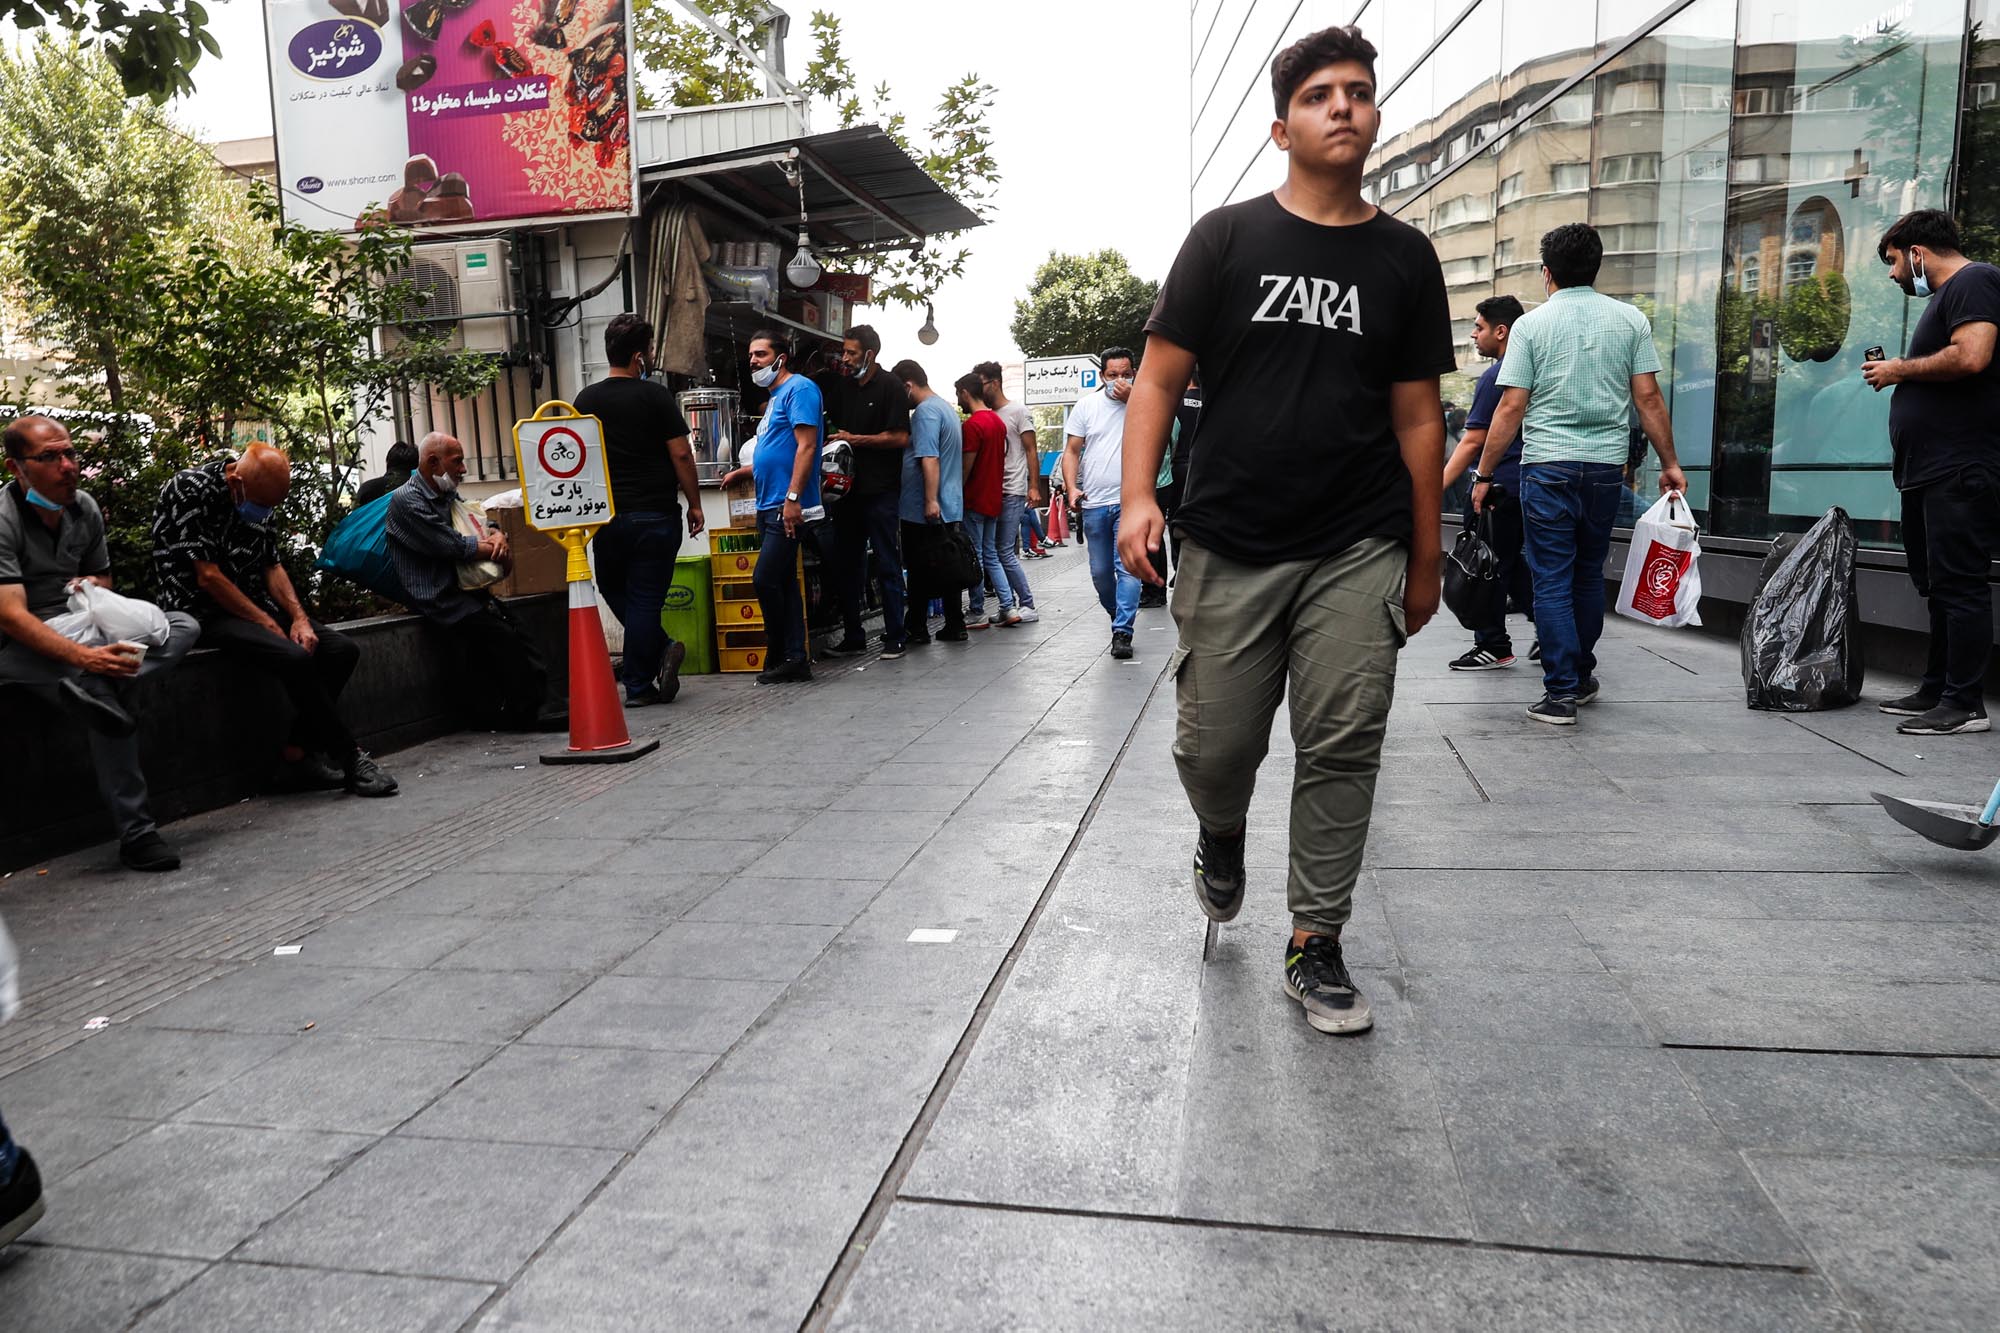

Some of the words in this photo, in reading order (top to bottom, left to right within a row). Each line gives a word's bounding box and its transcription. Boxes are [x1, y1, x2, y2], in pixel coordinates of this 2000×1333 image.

[1853, 0, 1913, 45] SAMSUNG
[307, 33, 365, 73] شونیز
[289, 90, 316, 102] شکلات
[504, 82, 548, 103] شکلات
[411, 92, 461, 117] مخلوط!
[327, 174, 397, 188] www.shoniz.com
[1251, 274, 1363, 336] ZARA
[1084, 371, 1094, 387] P
[1026, 387, 1053, 396] Charsou
[1054, 386, 1079, 395] Parking
[551, 481, 583, 499] پارک
[535, 502, 572, 520] ممنوع
[576, 498, 607, 516] موتور
